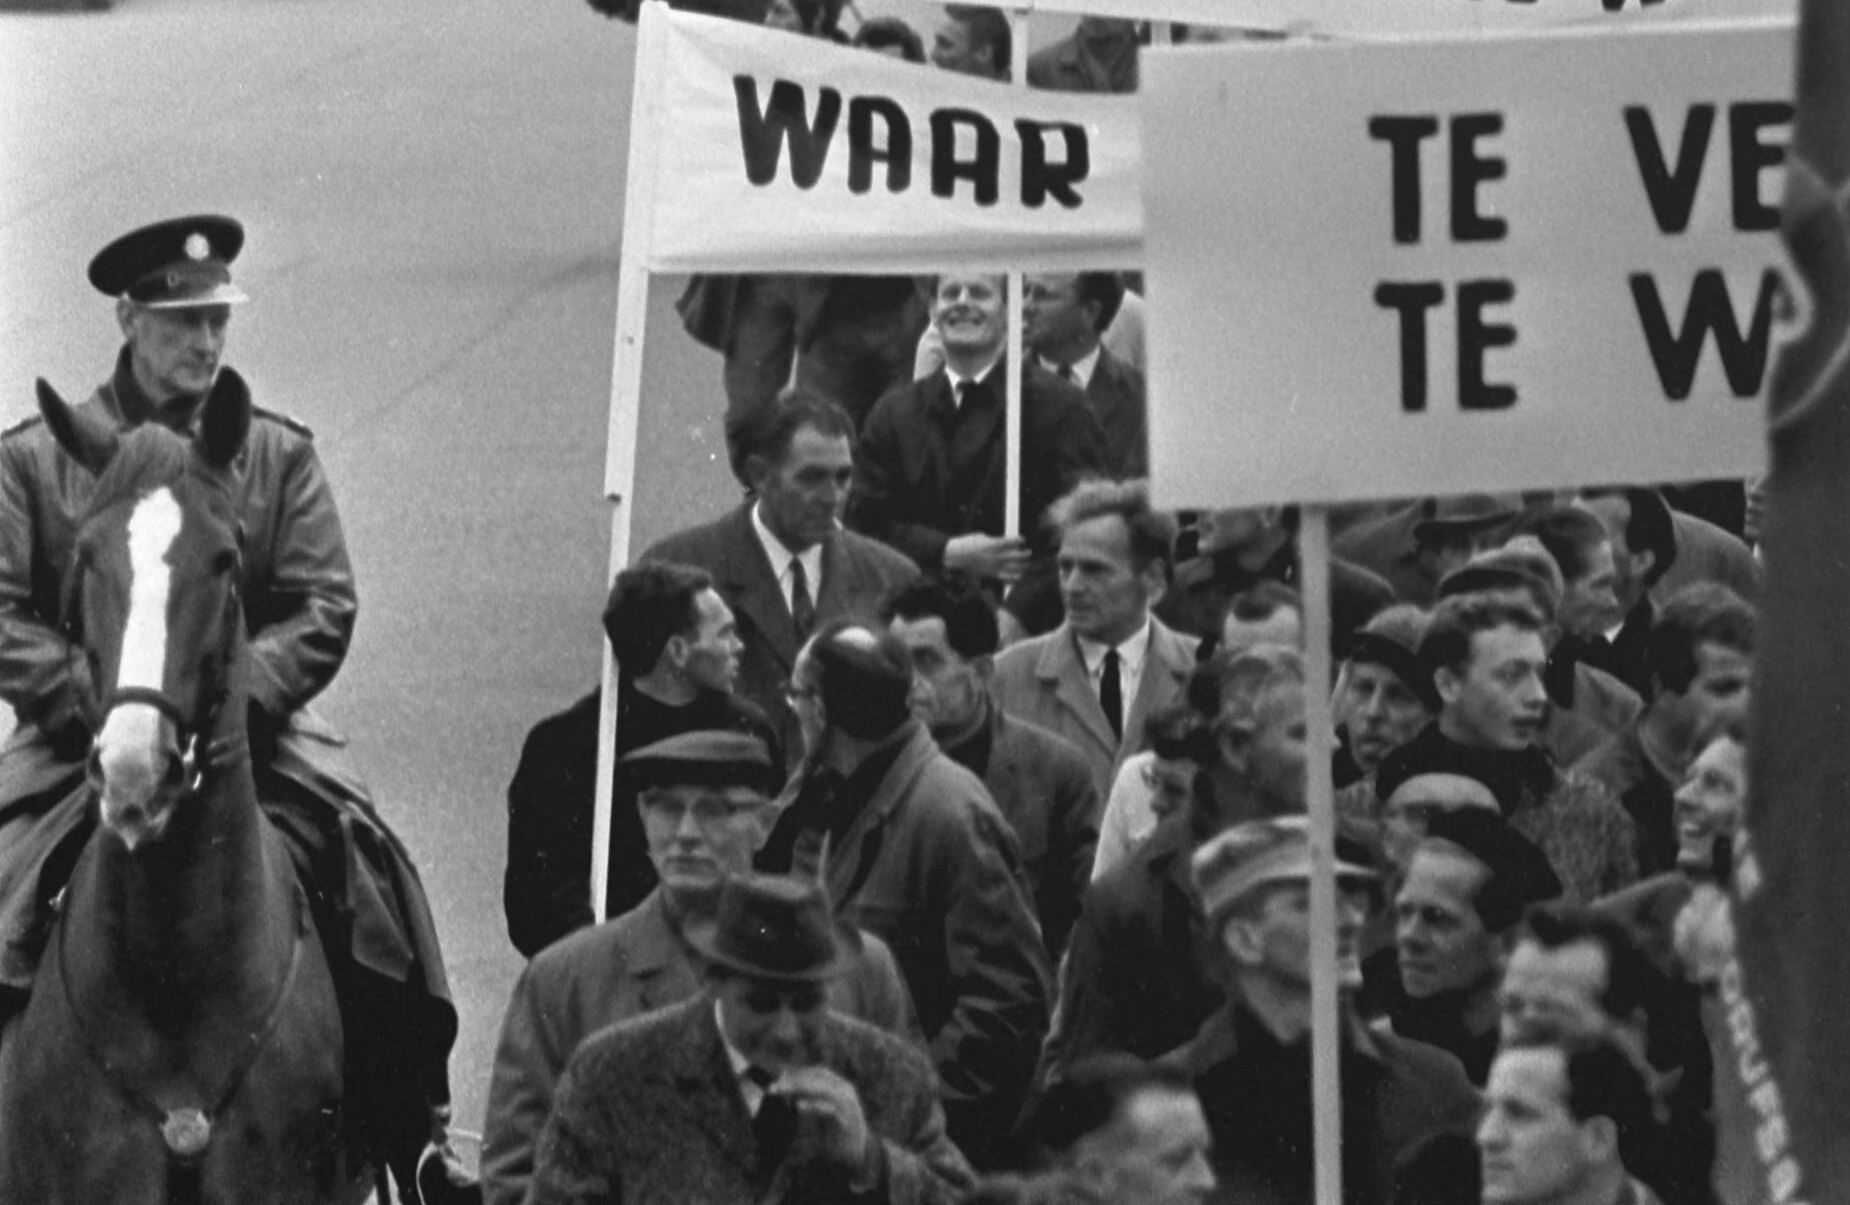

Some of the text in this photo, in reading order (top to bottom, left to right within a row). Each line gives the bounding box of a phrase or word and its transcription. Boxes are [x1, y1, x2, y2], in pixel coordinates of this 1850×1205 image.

[733, 74, 1091, 210] WAAR
[1369, 113, 1508, 245] TE
[1374, 280, 1518, 413] TE
